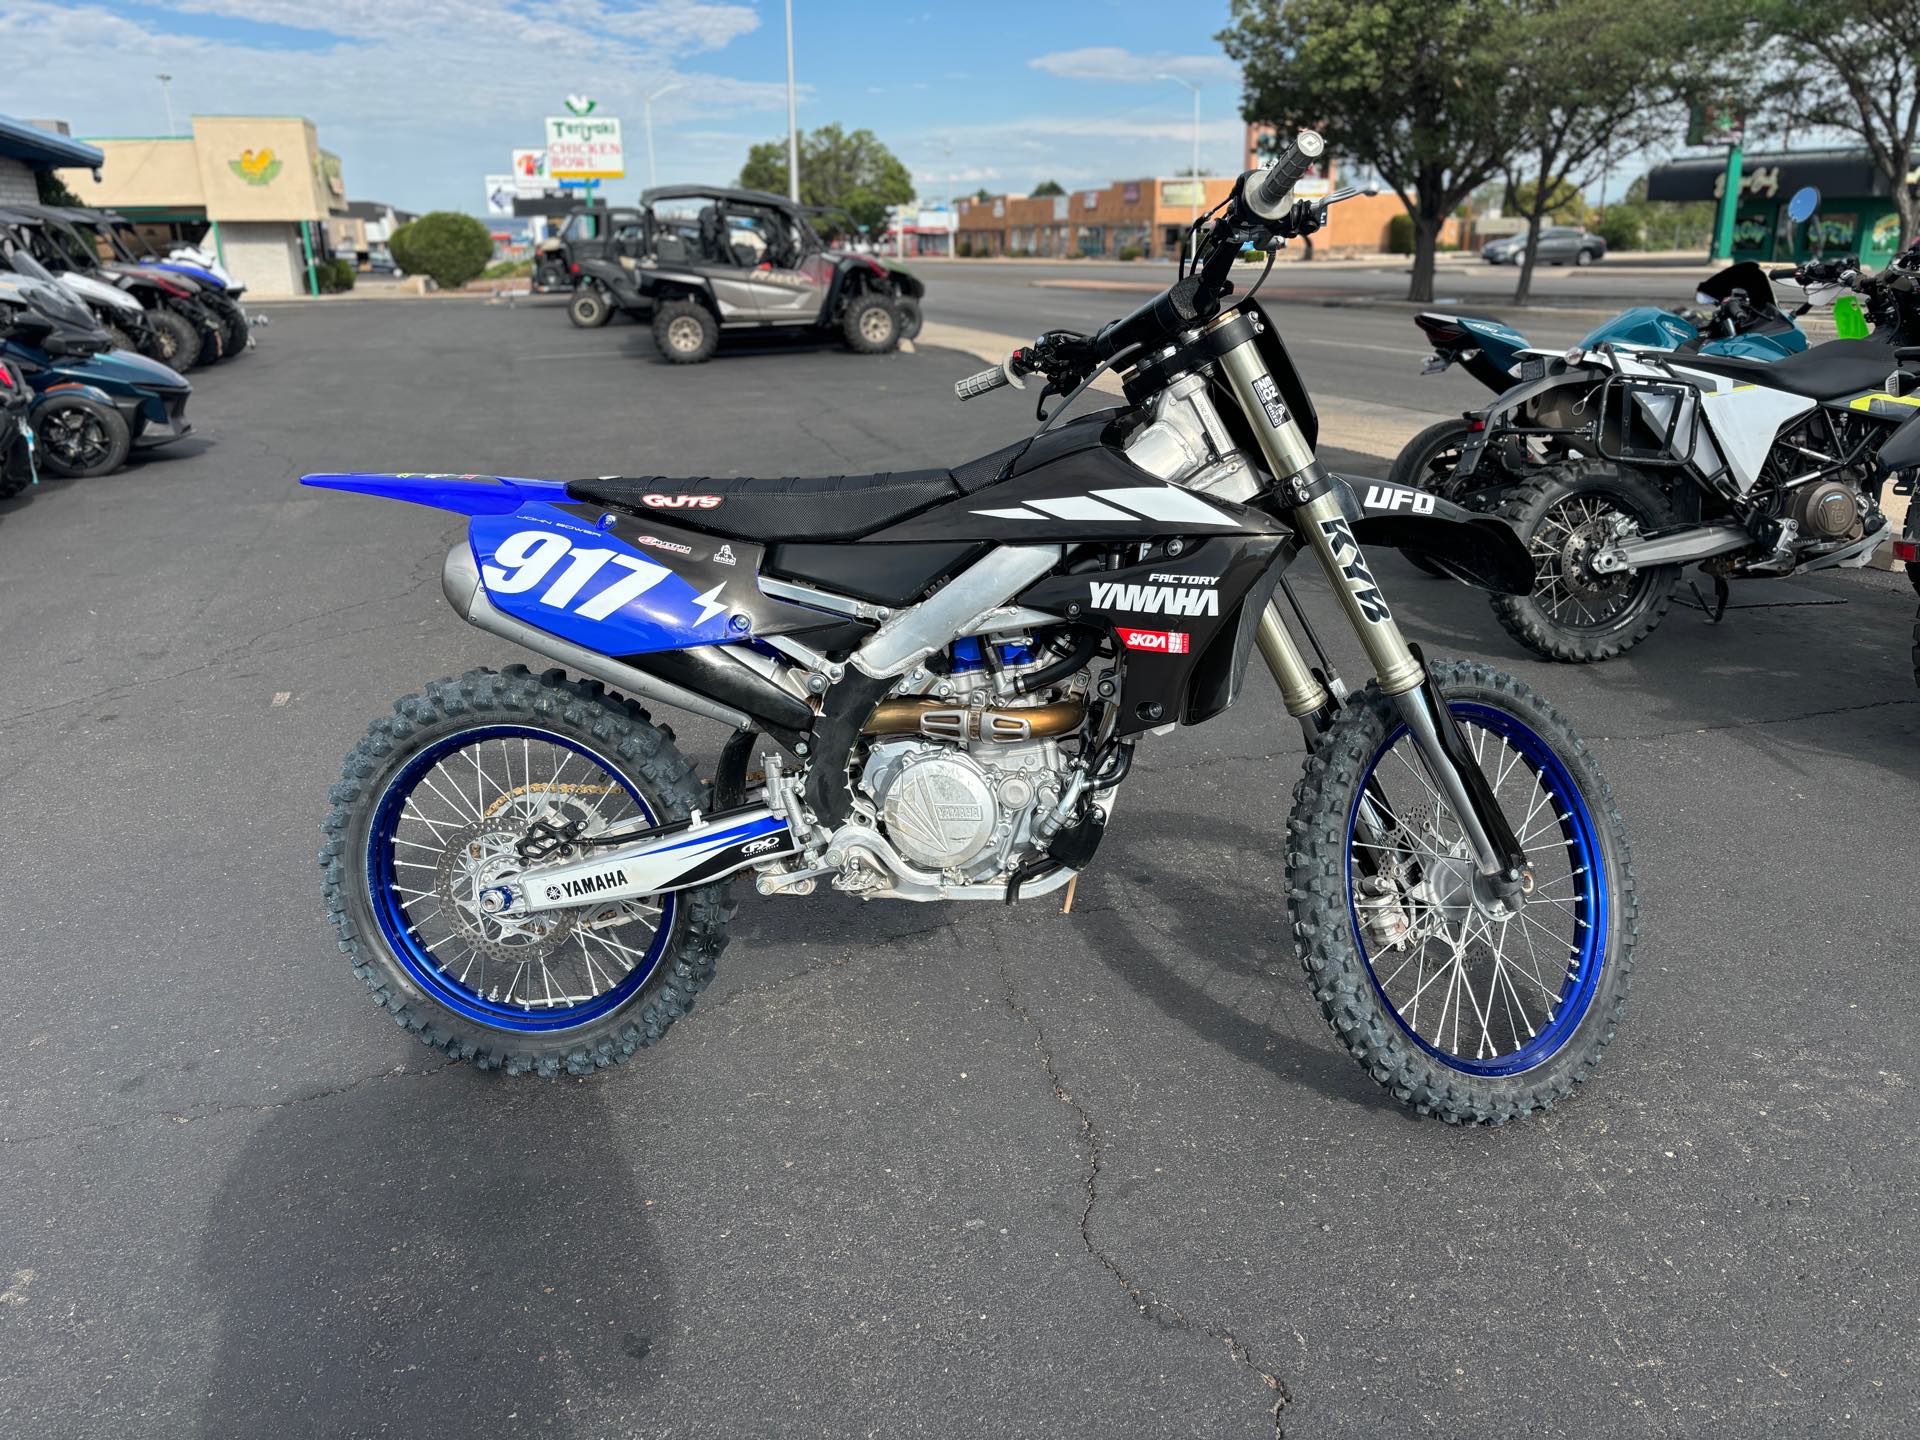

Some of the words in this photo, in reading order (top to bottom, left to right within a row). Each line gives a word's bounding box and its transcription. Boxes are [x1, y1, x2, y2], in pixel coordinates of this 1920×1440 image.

[552, 121, 615, 141] Teriyaki
[549, 143, 621, 155] CHICKEN
[551, 156, 597, 168] BOWL
[642, 494, 722, 509] GUTS
[1364, 486, 1435, 514] UFO
[516, 515, 552, 525] JOHN
[555, 523, 602, 537] BOWER
[482, 530, 672, 621] 917
[1149, 573, 1220, 586] FACTORY
[1317, 517, 1391, 625] KYB
[1089, 581, 1220, 617] YAMAHA
[1127, 632, 1166, 649] SKDA
[937, 806, 980, 819] YAMAHA
[561, 869, 629, 898] YAMAHA
